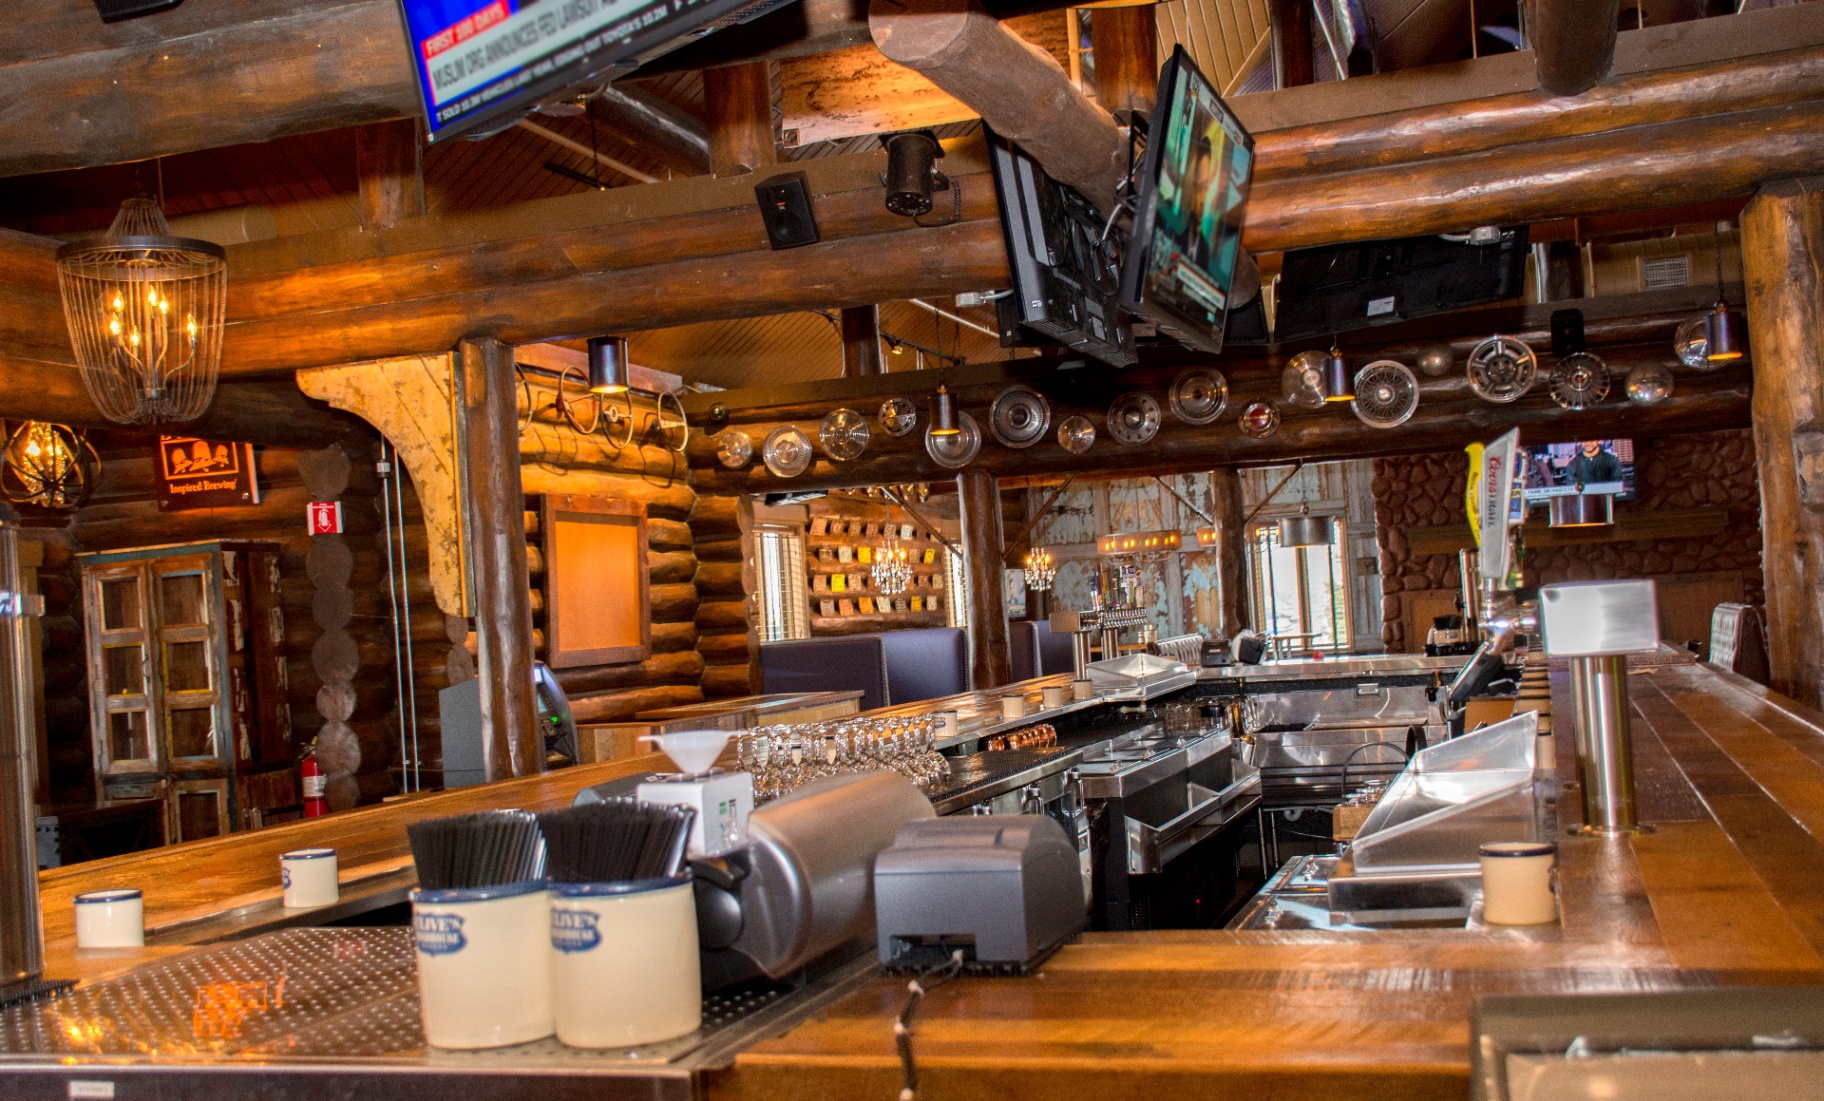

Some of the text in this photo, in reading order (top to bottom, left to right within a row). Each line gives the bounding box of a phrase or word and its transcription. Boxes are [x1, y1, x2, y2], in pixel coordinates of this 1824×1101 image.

[425, 28, 455, 56] FIRST
[473, 5, 505, 31] DAYS
[432, 56, 467, 90] MUSLIM
[465, 47, 485, 75] ORG
[484, 20, 539, 65] ANNOUNCES
[442, 102, 460, 120] SOLD
[602, 16, 642, 43] TOYOTA'S
[169, 480, 236, 494] Inspired Brewing
[1488, 456, 1502, 493] Coors
[1487, 494, 1497, 525] LIGHT
[416, 917, 462, 932] LIVE'S
